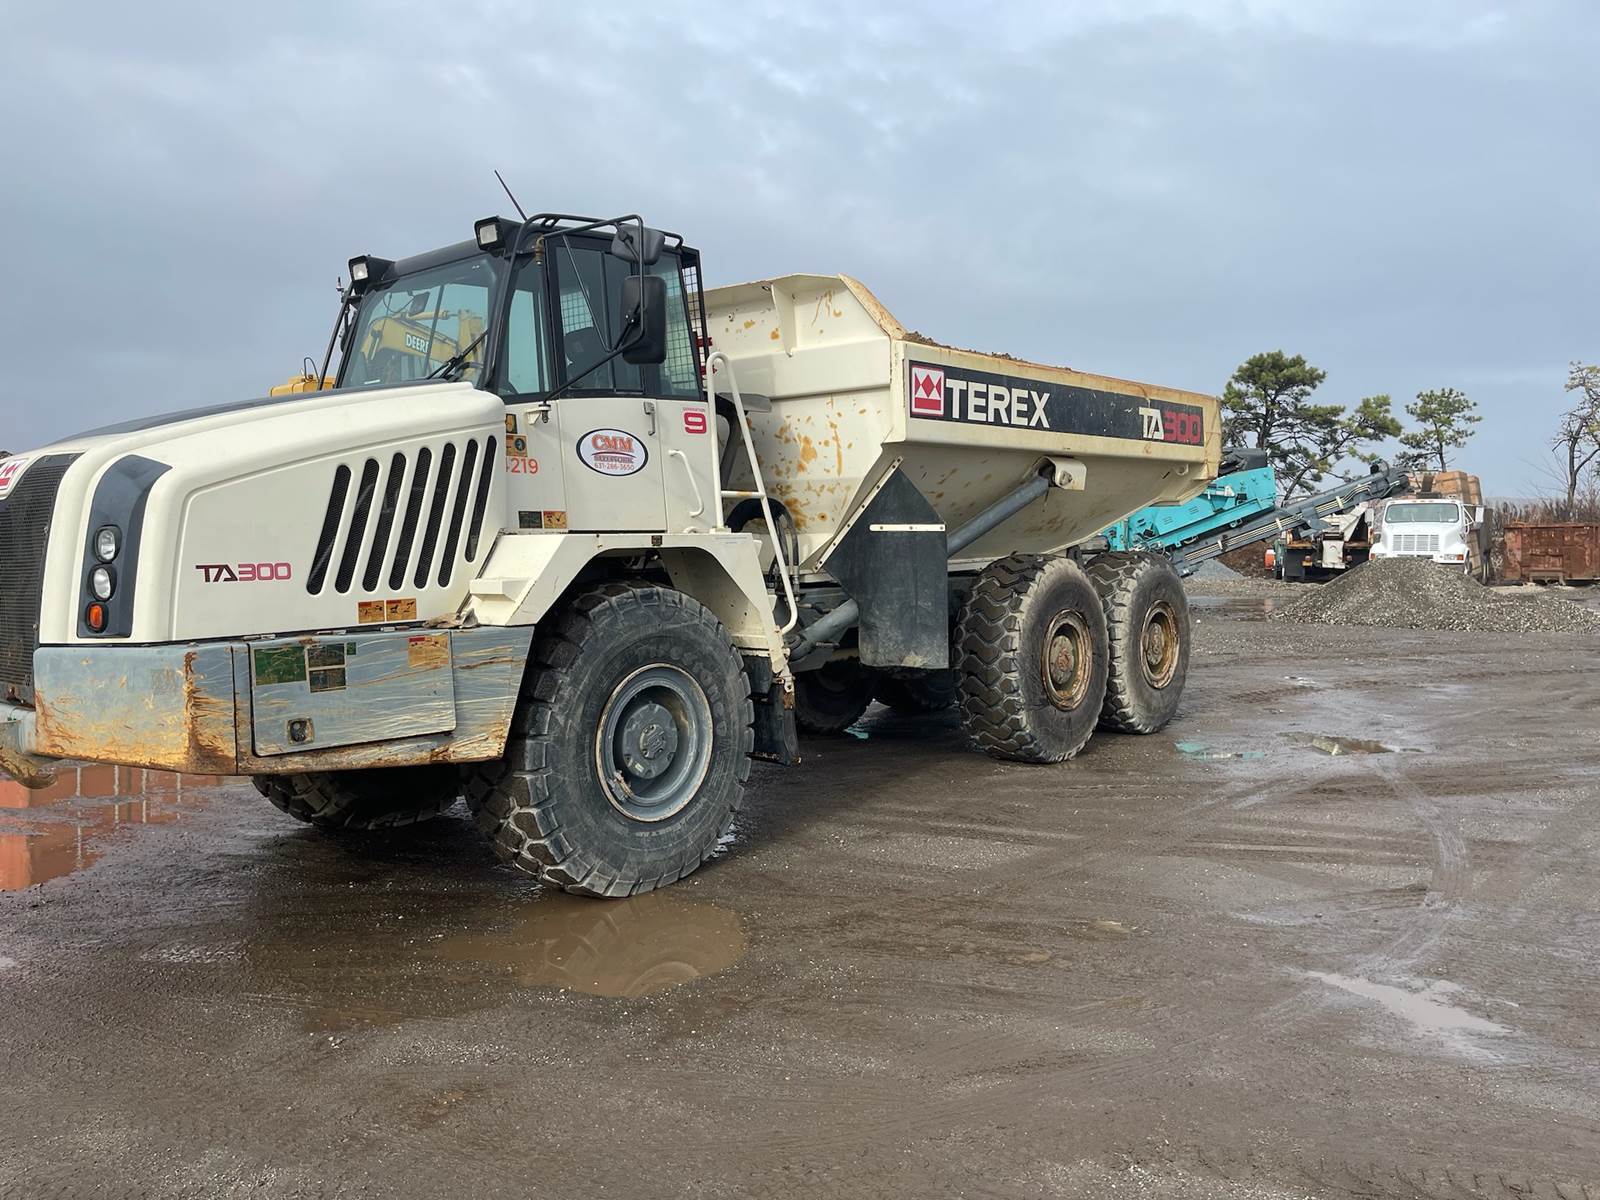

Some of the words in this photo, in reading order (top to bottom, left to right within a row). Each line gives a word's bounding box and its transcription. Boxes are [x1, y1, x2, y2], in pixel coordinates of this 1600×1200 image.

[945, 378, 1051, 429] TEREX
[684, 412, 707, 434] 9
[1139, 406, 1201, 444] TA300
[591, 434, 634, 452] CMM
[195, 562, 291, 583] TA300
